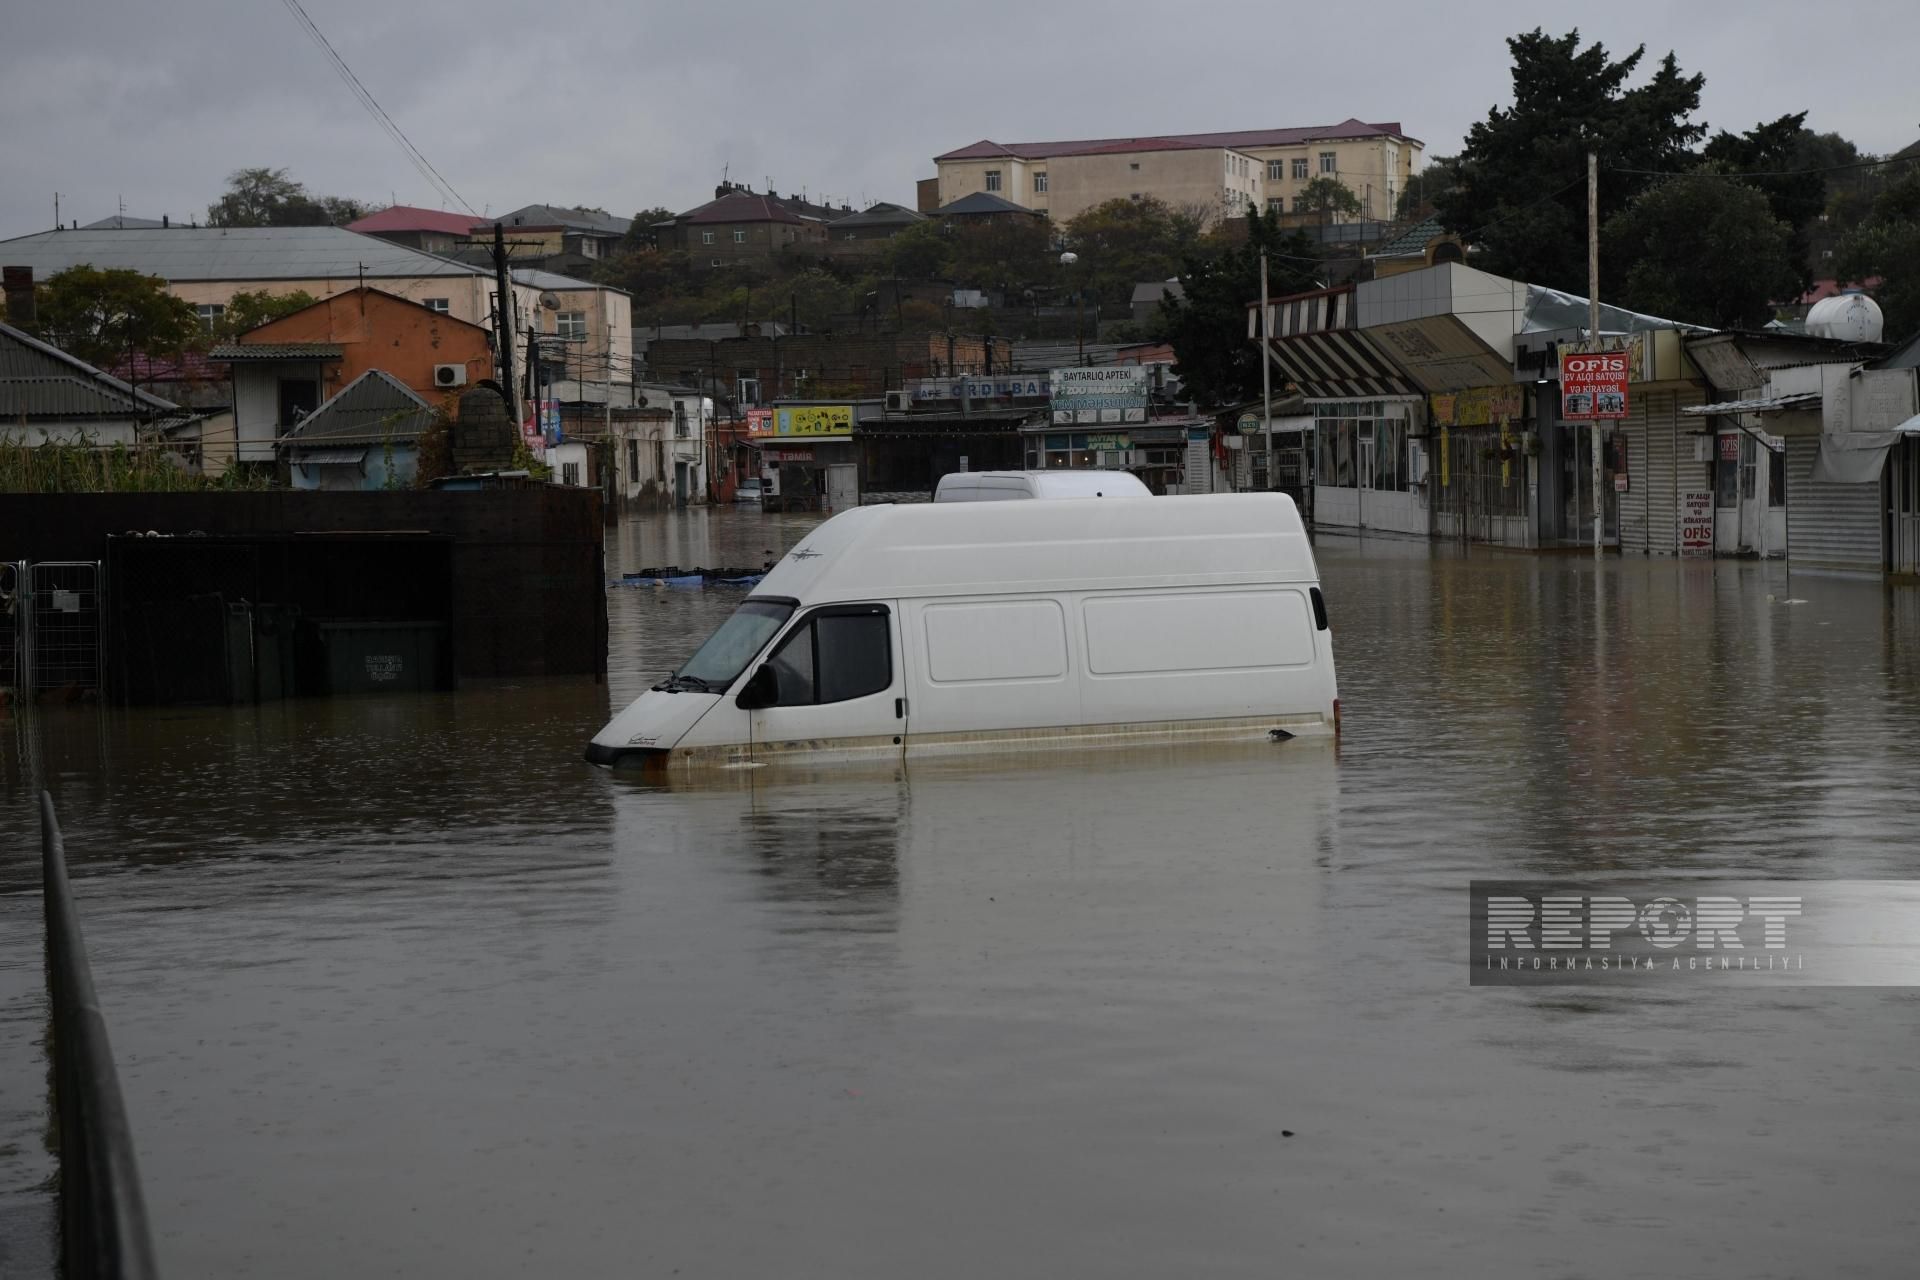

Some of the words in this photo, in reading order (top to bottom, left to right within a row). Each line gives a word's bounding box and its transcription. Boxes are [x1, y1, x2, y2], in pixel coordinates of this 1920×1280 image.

[1568, 357, 1624, 372] OFİS
[1064, 371, 1104, 382] BAYTARLIQ
[1105, 368, 1131, 380] APTEKİ
[1565, 373, 1575, 382] EV
[1577, 372, 1594, 382] ALQI
[1595, 372, 1625, 381] SATQISI
[1570, 385, 1581, 393] VƏ
[1582, 382, 1619, 393] KİRAYƏSİ
[1720, 437, 1738, 451] OFİS
[782, 451, 814, 461] TƏMİR
[1683, 525, 1711, 539] OFİS
